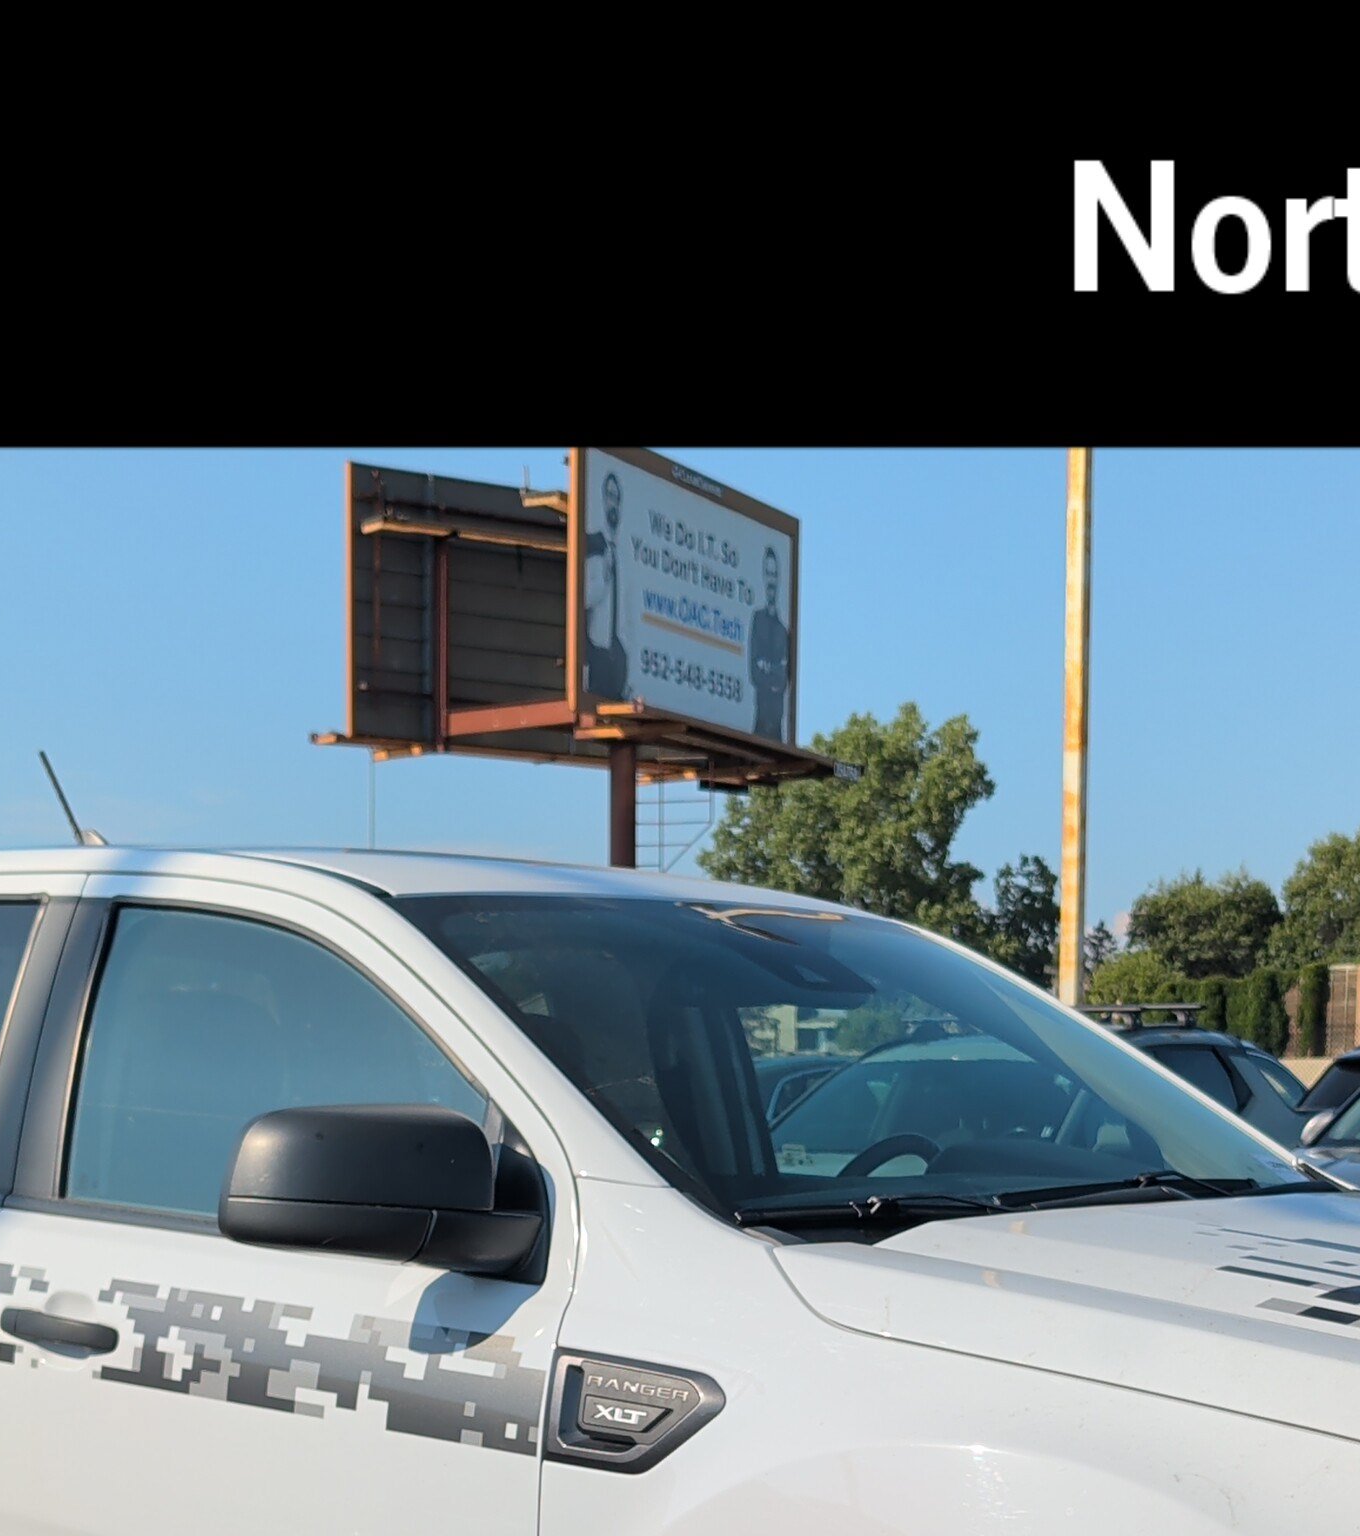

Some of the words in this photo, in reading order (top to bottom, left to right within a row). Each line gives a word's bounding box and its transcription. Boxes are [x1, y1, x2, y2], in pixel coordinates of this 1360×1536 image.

[648, 508, 672, 541] We
[675, 521, 696, 551] Do
[721, 541, 738, 570] So
[630, 533, 659, 570] You
[661, 548, 700, 586] Don't
[700, 564, 734, 599] Have
[737, 577, 756, 607] To
[586, 1373, 690, 1402] RANGER
[593, 1402, 648, 1426] XLT
